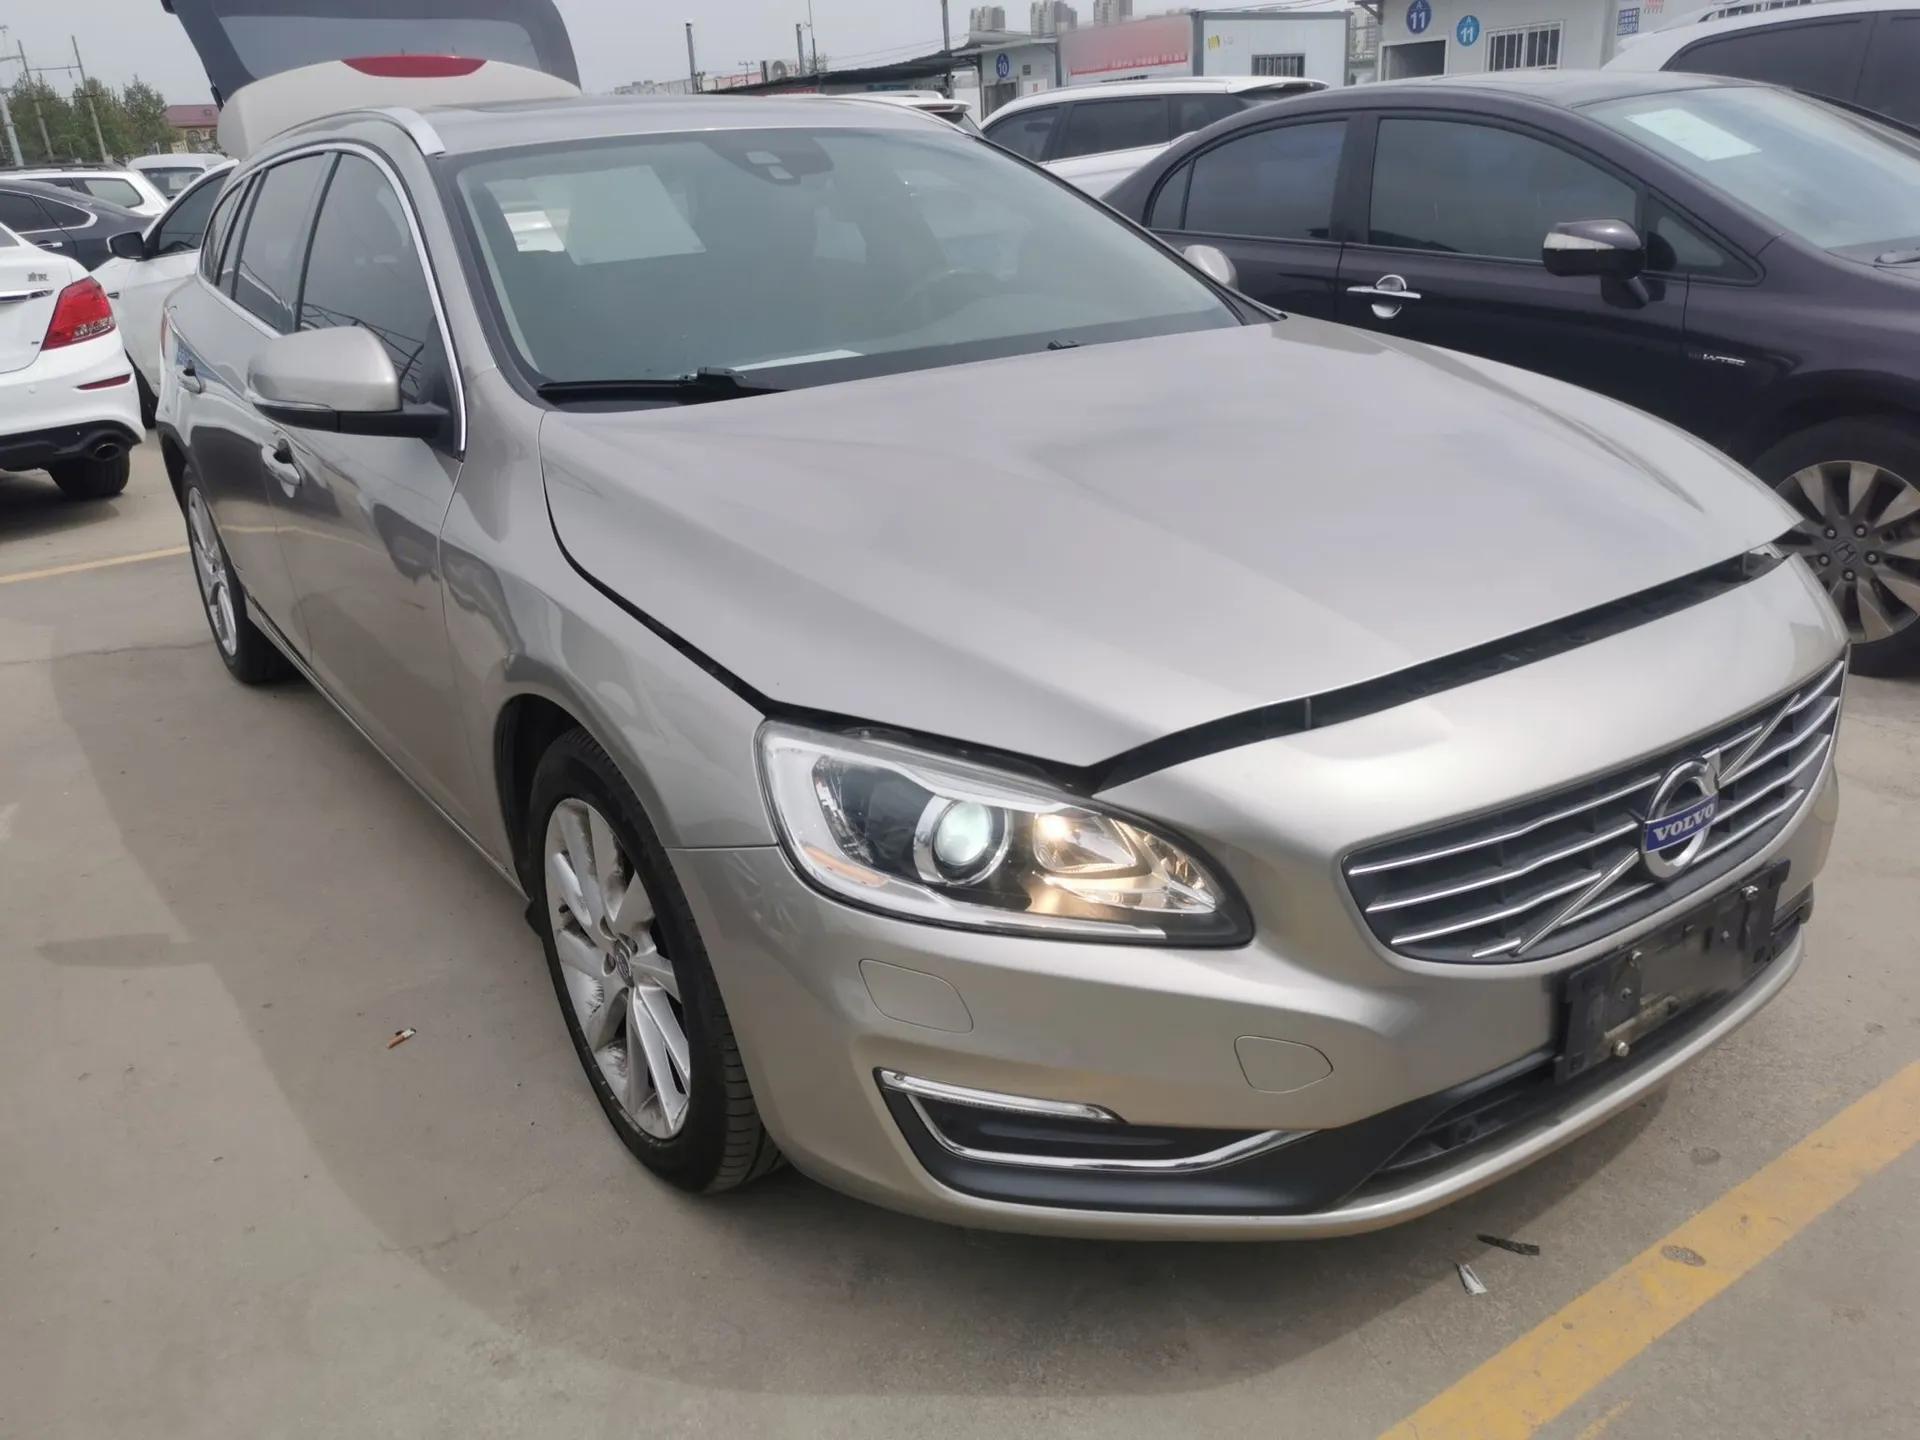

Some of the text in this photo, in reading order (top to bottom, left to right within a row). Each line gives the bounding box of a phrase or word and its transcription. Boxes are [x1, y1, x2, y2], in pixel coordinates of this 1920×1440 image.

[1410, 11, 1426, 30] 11
[1460, 26, 1474, 43] 11
[998, 62, 1008, 76] 10
[1653, 803, 1715, 841] VOLVO
